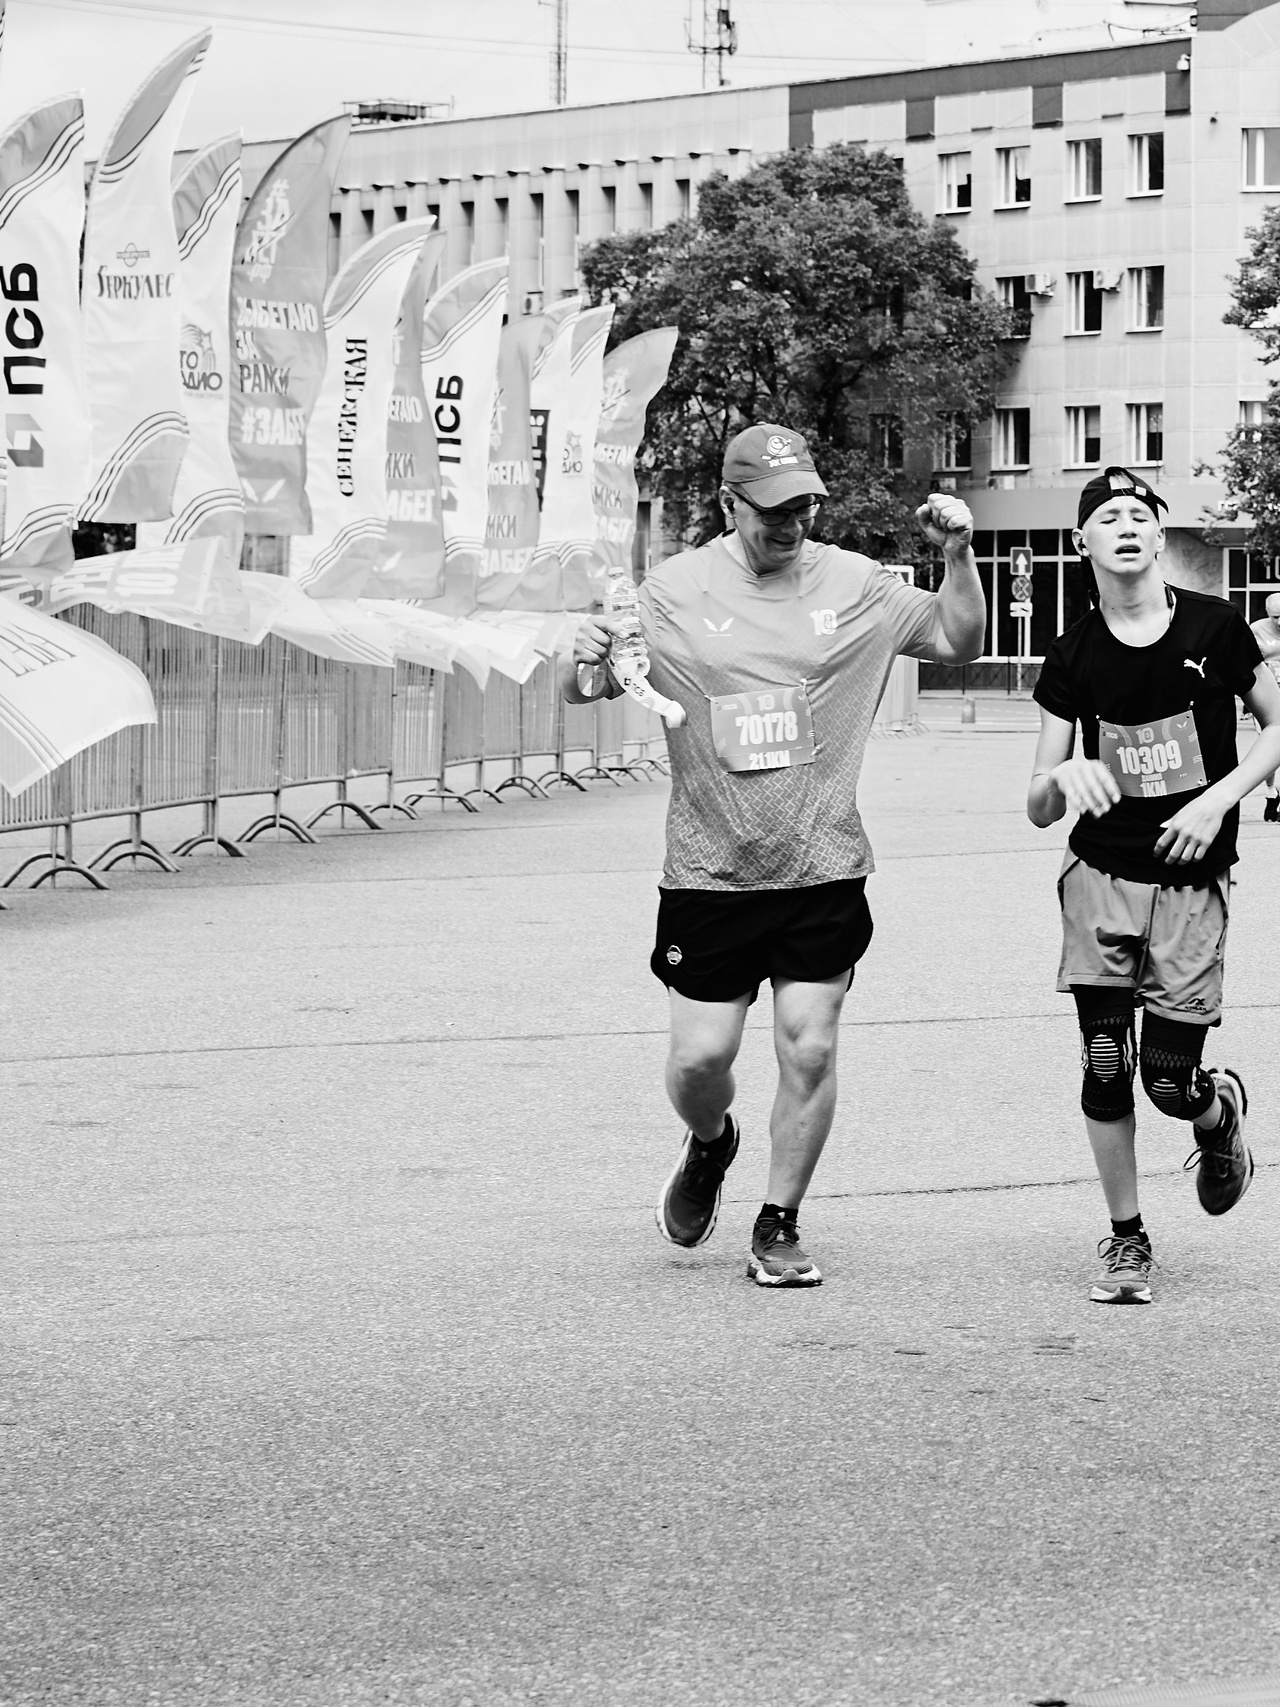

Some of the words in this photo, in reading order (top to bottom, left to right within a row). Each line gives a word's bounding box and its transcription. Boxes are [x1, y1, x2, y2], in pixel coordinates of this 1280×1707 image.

[0, 262, 46, 395] ПСБ
[336, 337, 368, 497] СЕНЕЖСКАЯ
[809, 609, 838, 635] 10
[735, 711, 798, 746] 70178
[1116, 739, 1183, 775] 10309
